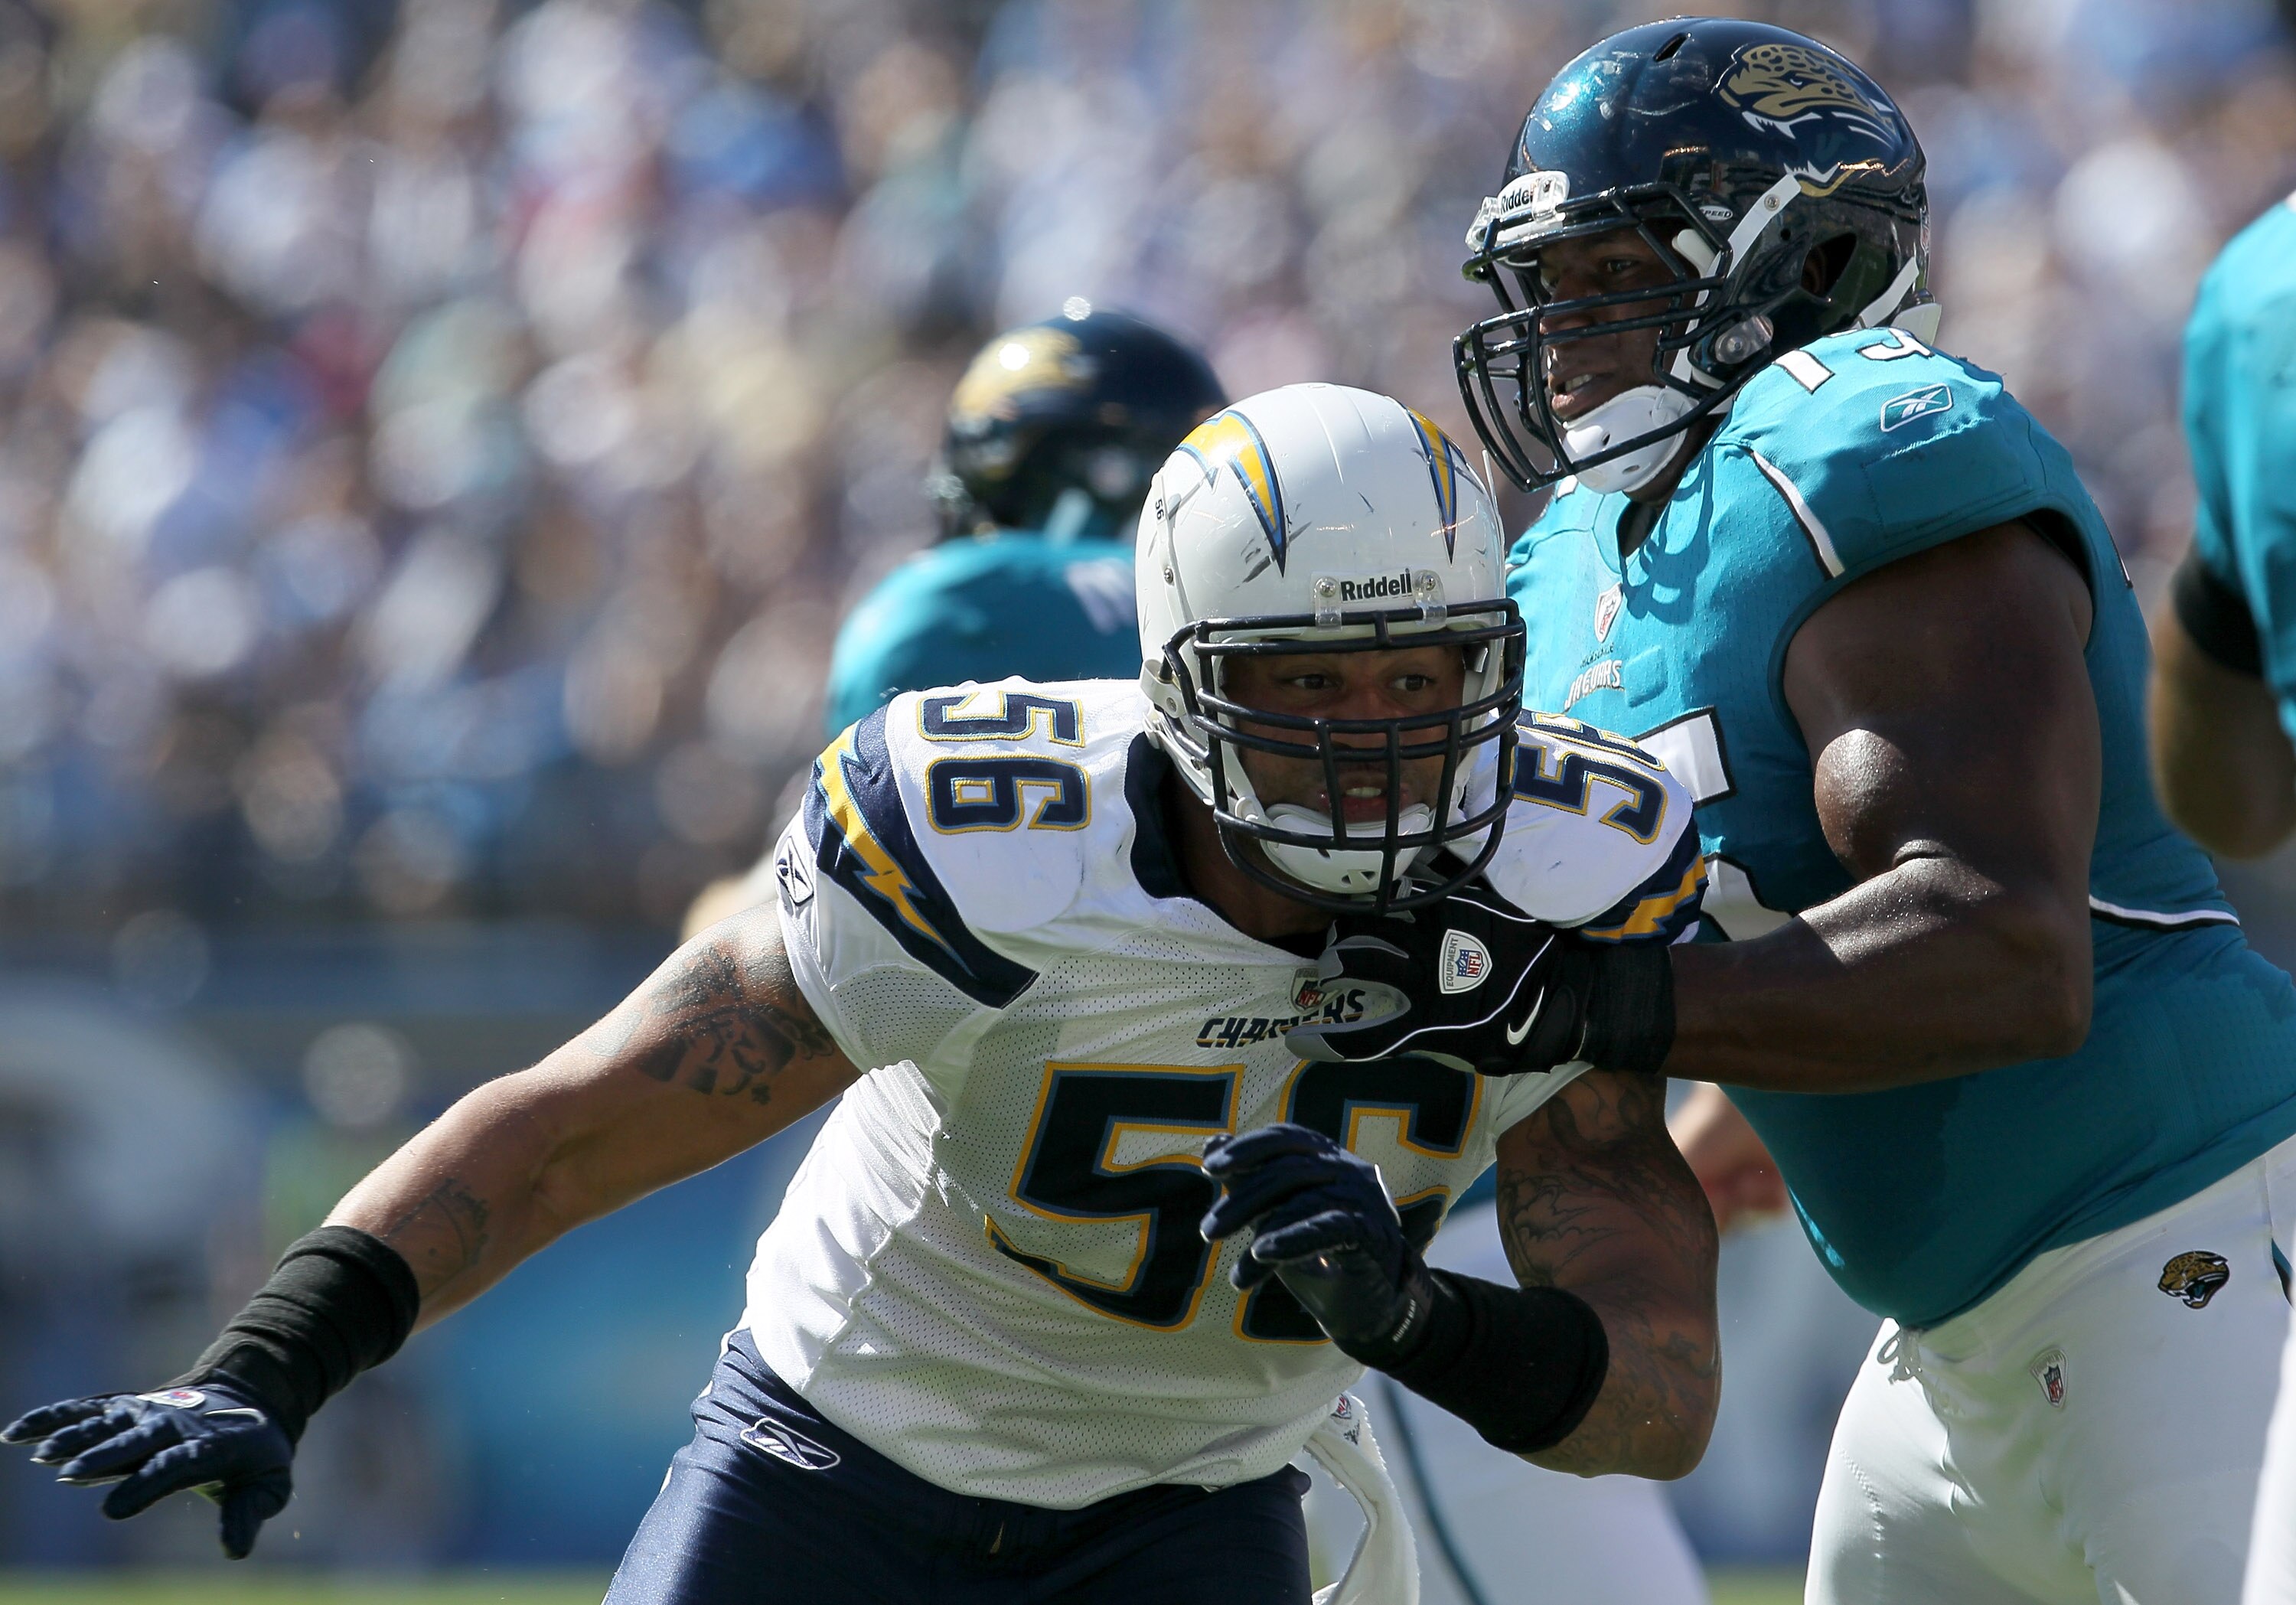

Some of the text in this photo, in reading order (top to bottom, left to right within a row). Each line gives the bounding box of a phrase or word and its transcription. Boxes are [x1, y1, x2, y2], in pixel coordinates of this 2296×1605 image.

[1156, 498, 1164, 520] 56
[1340, 573, 1413, 602] Riddell
[1564, 659, 1623, 710] JAGUARS
[918, 691, 1091, 833] 56
[1446, 938, 1459, 987] EQUIPMENT
[1466, 952, 1482, 976] NFL
[984, 1059, 1482, 1345] 56
